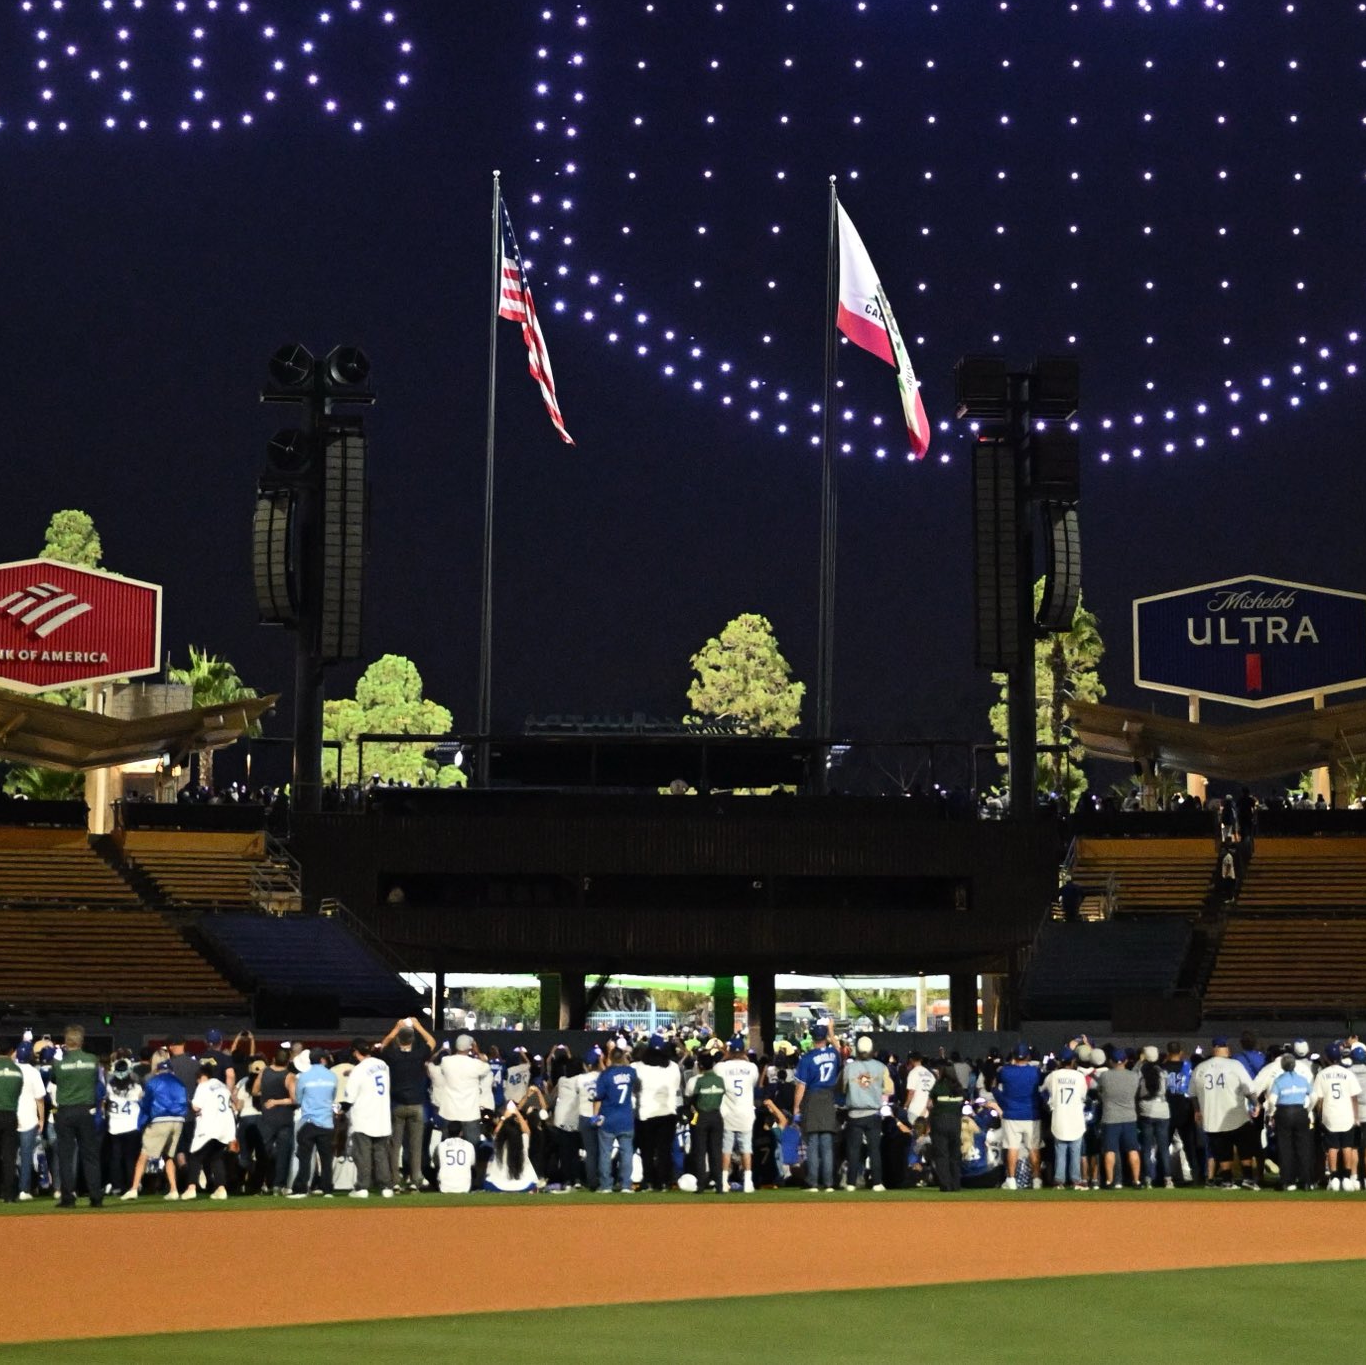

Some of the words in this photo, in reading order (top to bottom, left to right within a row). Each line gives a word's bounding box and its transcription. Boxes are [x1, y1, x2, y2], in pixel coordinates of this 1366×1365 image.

[1206, 590, 1296, 613] Michelob
[1187, 616, 1319, 646] ULTRA
[18, 649, 38, 661] OF
[41, 650, 109, 663] AMERICA
[819, 1062, 835, 1083] 17
[375, 1075, 385, 1096] 5
[733, 1080, 743, 1097] 5
[1205, 1073, 1226, 1090] 34
[617, 1084, 629, 1104] 7
[1060, 1088, 1074, 1105] 17
[1331, 1083, 1342, 1100] 5
[446, 1149, 466, 1166] 50
